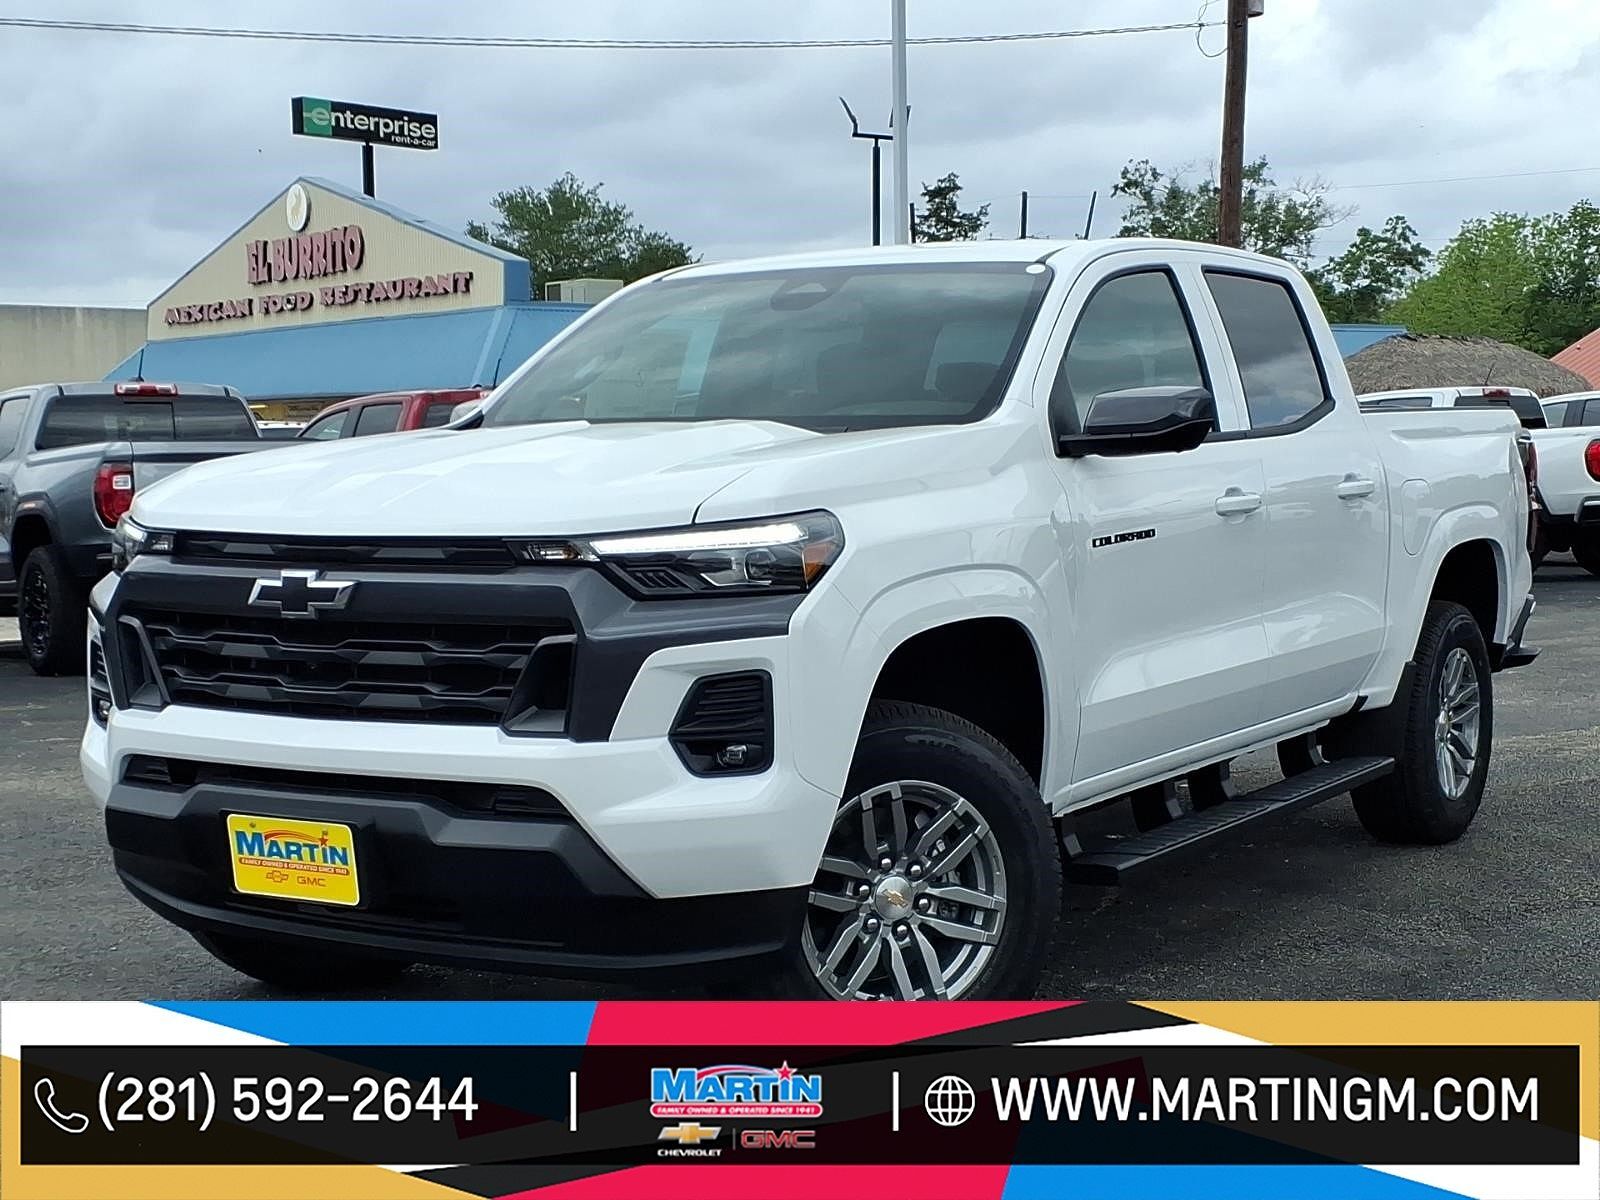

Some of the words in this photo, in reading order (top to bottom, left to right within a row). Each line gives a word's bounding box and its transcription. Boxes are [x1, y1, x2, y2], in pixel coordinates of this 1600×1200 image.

[310, 107, 436, 138] enterprise
[391, 134, 436, 147] rent-a-car
[246, 240, 273, 284] EL
[272, 225, 364, 282] BURRITO
[164, 299, 253, 326] MEXICAN
[259, 291, 313, 315] FOOD
[319, 271, 473, 307] RESTAURANT
[1092, 528, 1156, 548] COLORADO
[235, 830, 349, 866] MARTIN
[296, 875, 327, 887] GMC
